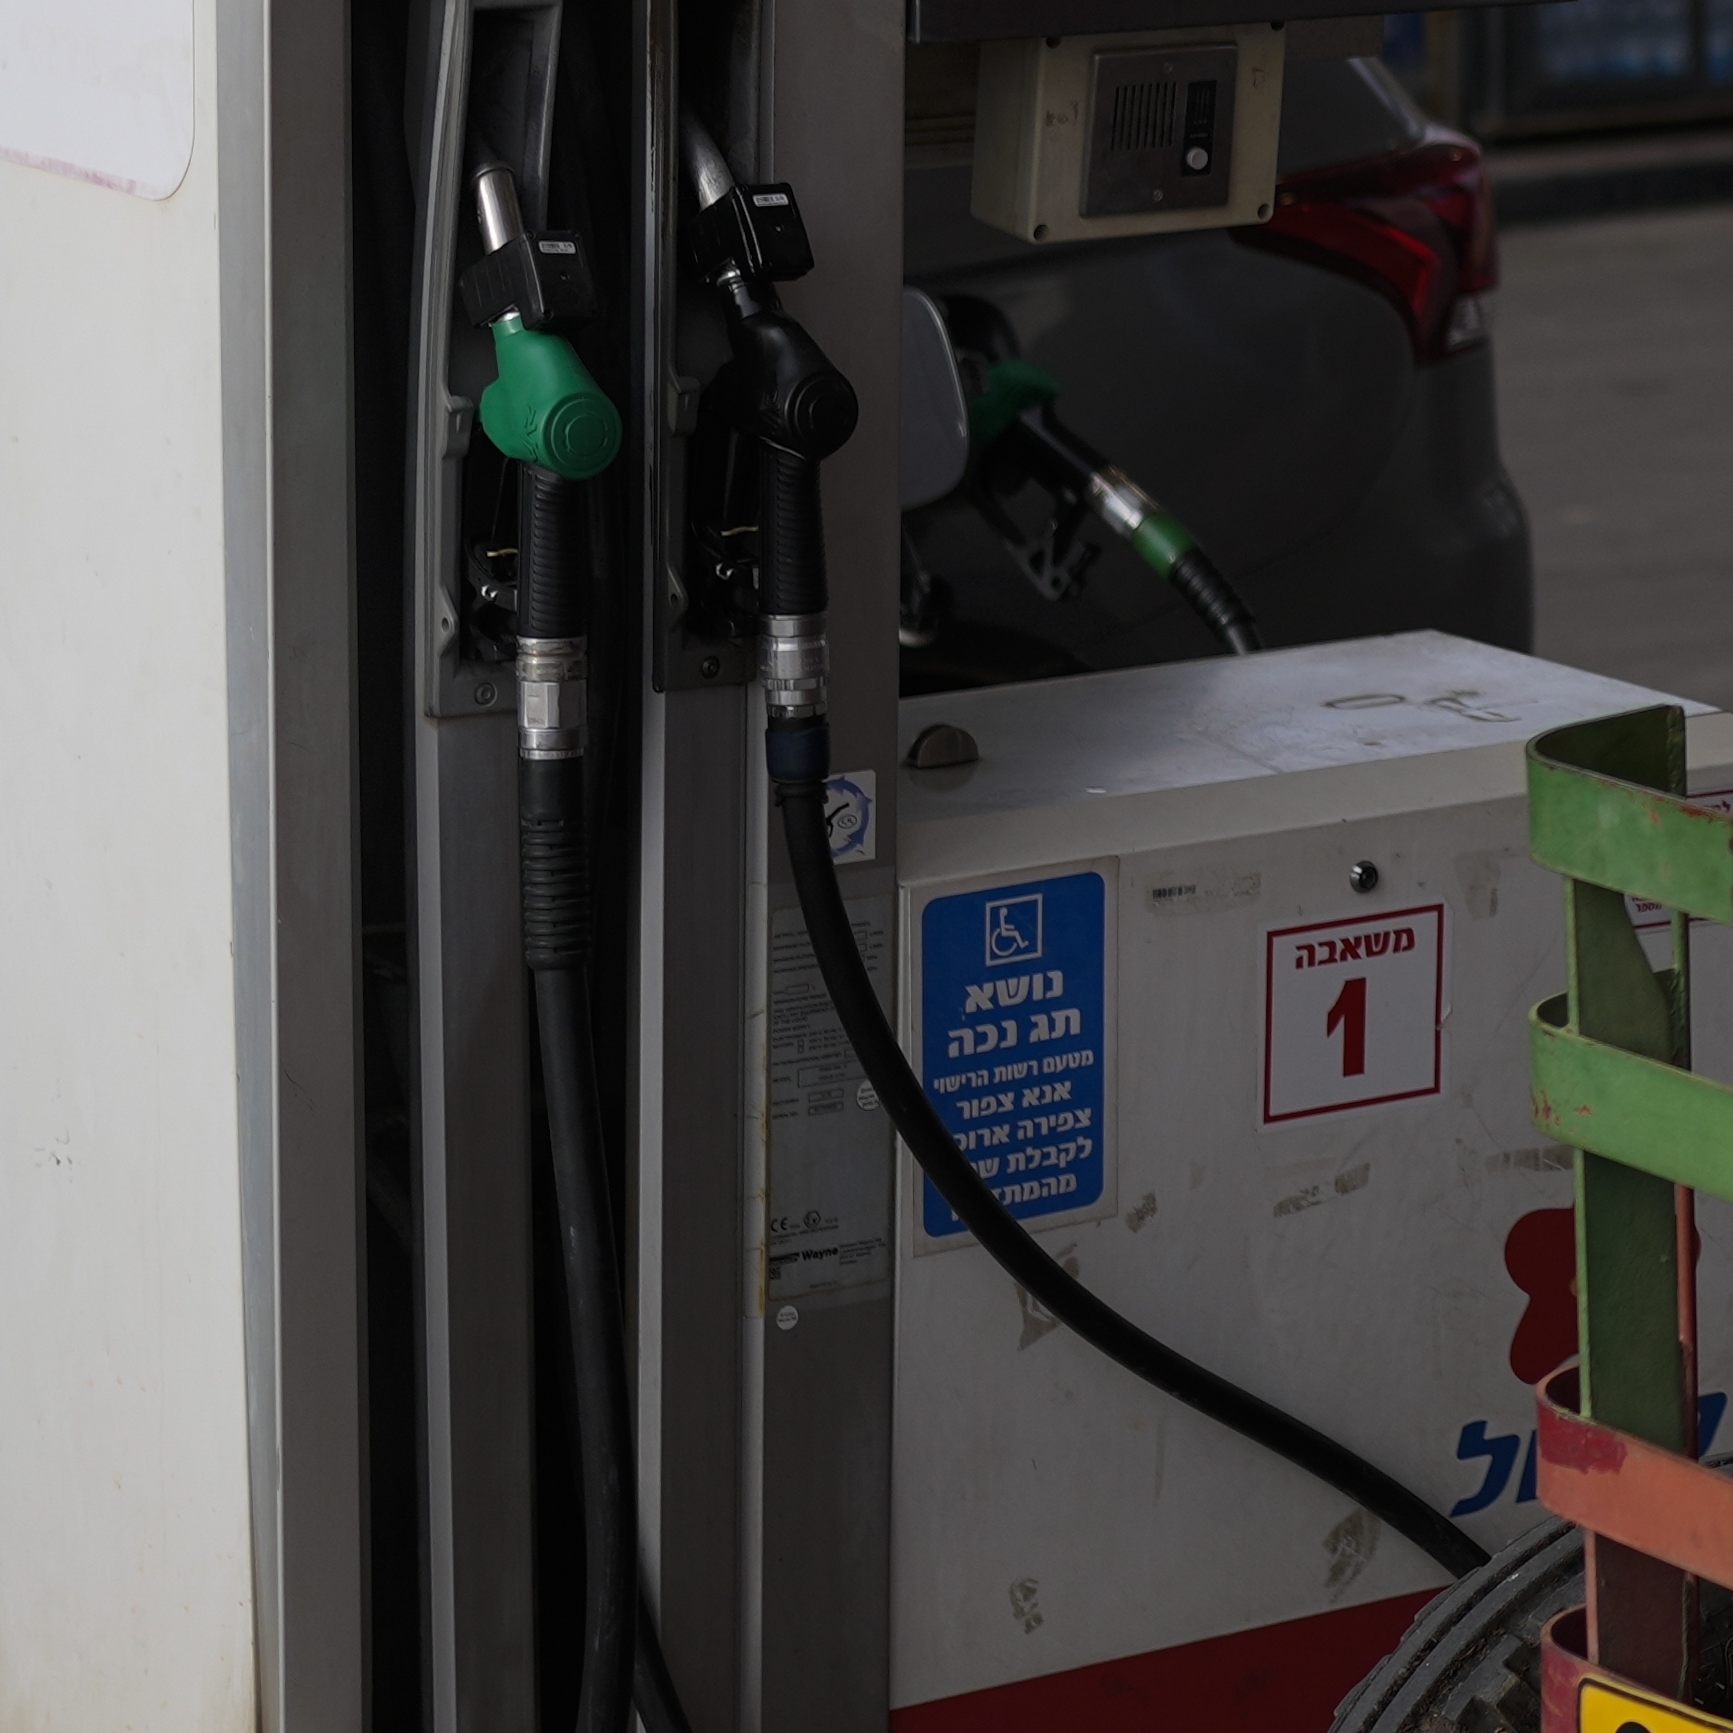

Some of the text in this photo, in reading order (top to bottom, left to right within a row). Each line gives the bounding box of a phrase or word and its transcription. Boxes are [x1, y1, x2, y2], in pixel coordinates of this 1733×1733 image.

[1294, 926, 1415, 972] משאבה
[964, 970, 1064, 1014] נושא
[948, 1008, 1082, 1059] תג נכה
[1326, 976, 1368, 1079] 1
[933, 1048, 1094, 1095] מטעם רשות הרישוי
[957, 1081, 1071, 1121] אנא צפור
[1017, 1107, 1092, 1142] צפירה
[1007, 1137, 1093, 1176] לקבלת
[802, 1248, 838, 1261] Wayne
